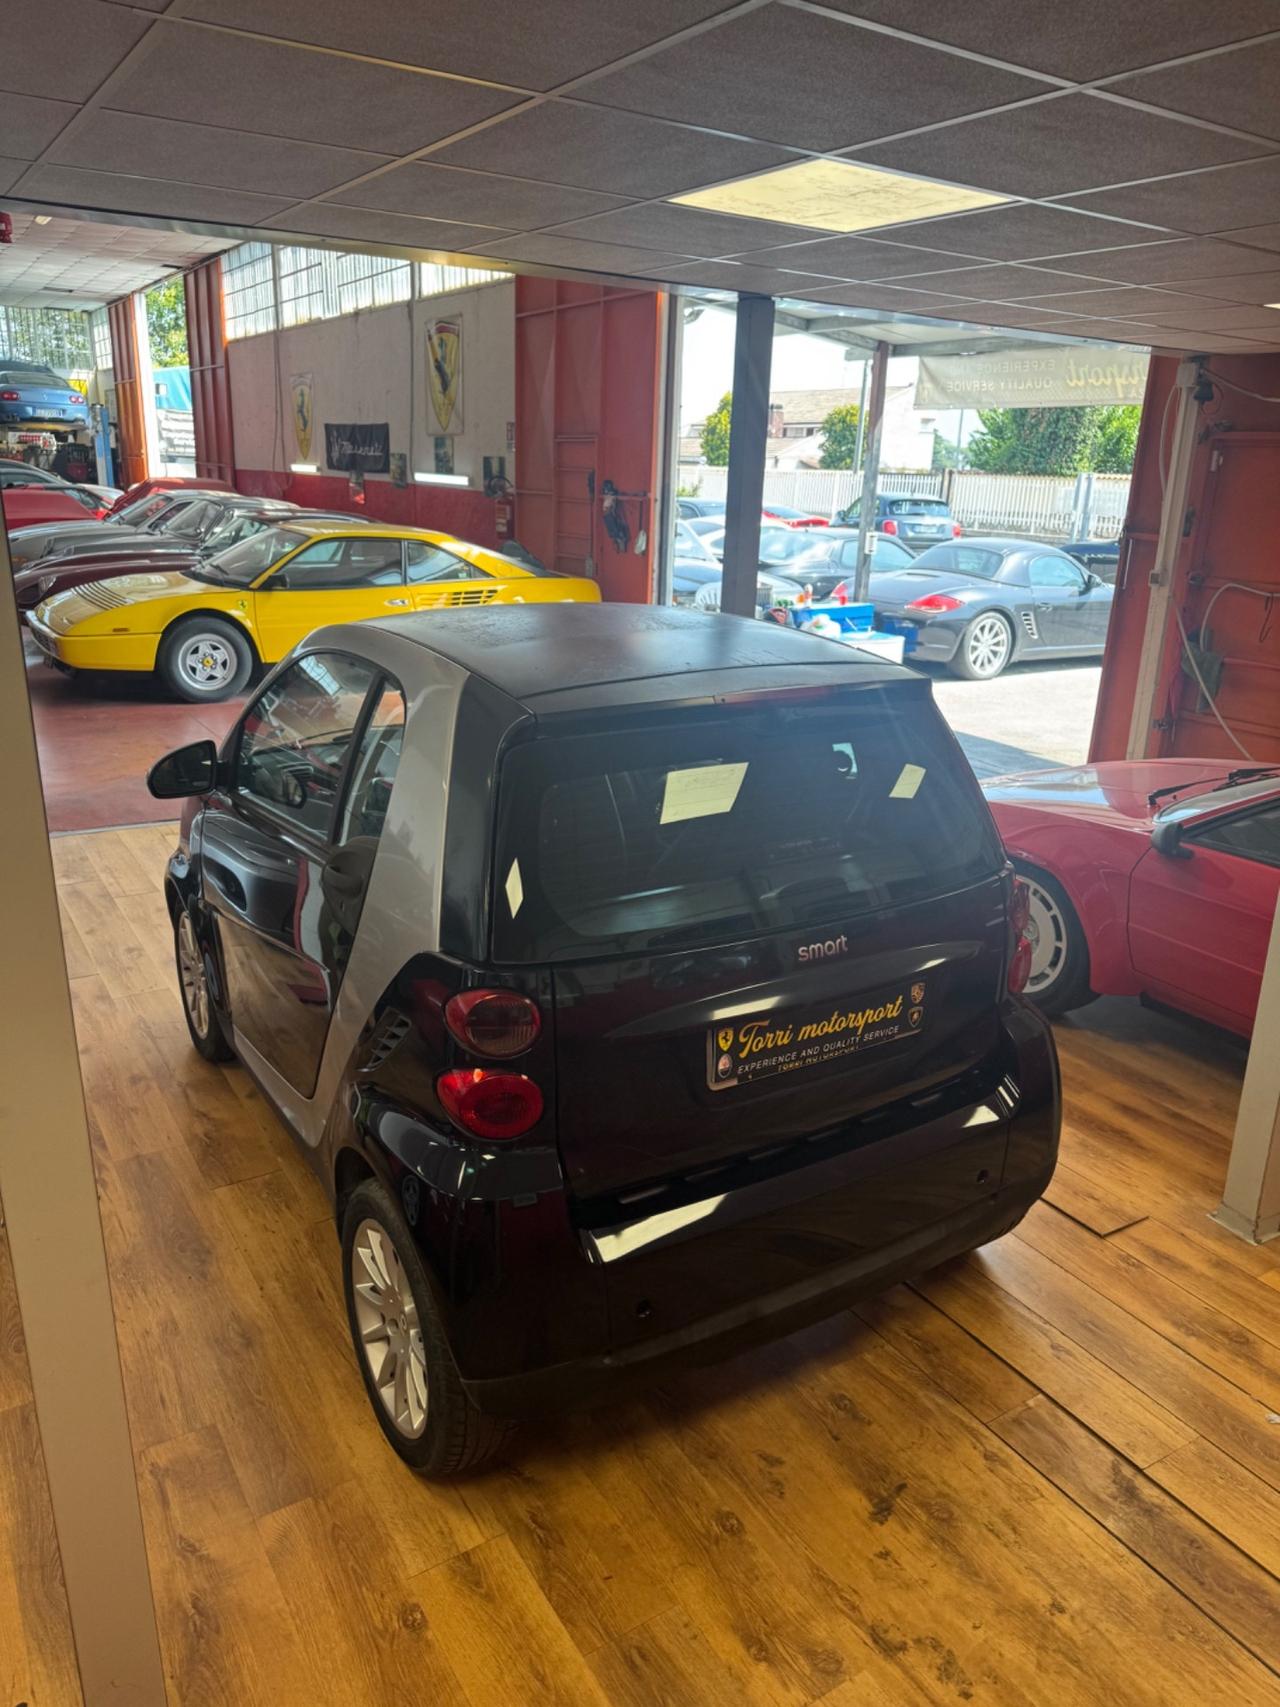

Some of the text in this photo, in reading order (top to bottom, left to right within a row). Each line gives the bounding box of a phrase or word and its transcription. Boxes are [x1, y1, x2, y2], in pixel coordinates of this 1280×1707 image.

[798, 934, 849, 962] smart
[737, 1025, 900, 1074] EXPERIENCE AND QUALITY SERVICE
[738, 995, 903, 1058] Torri motorsport
